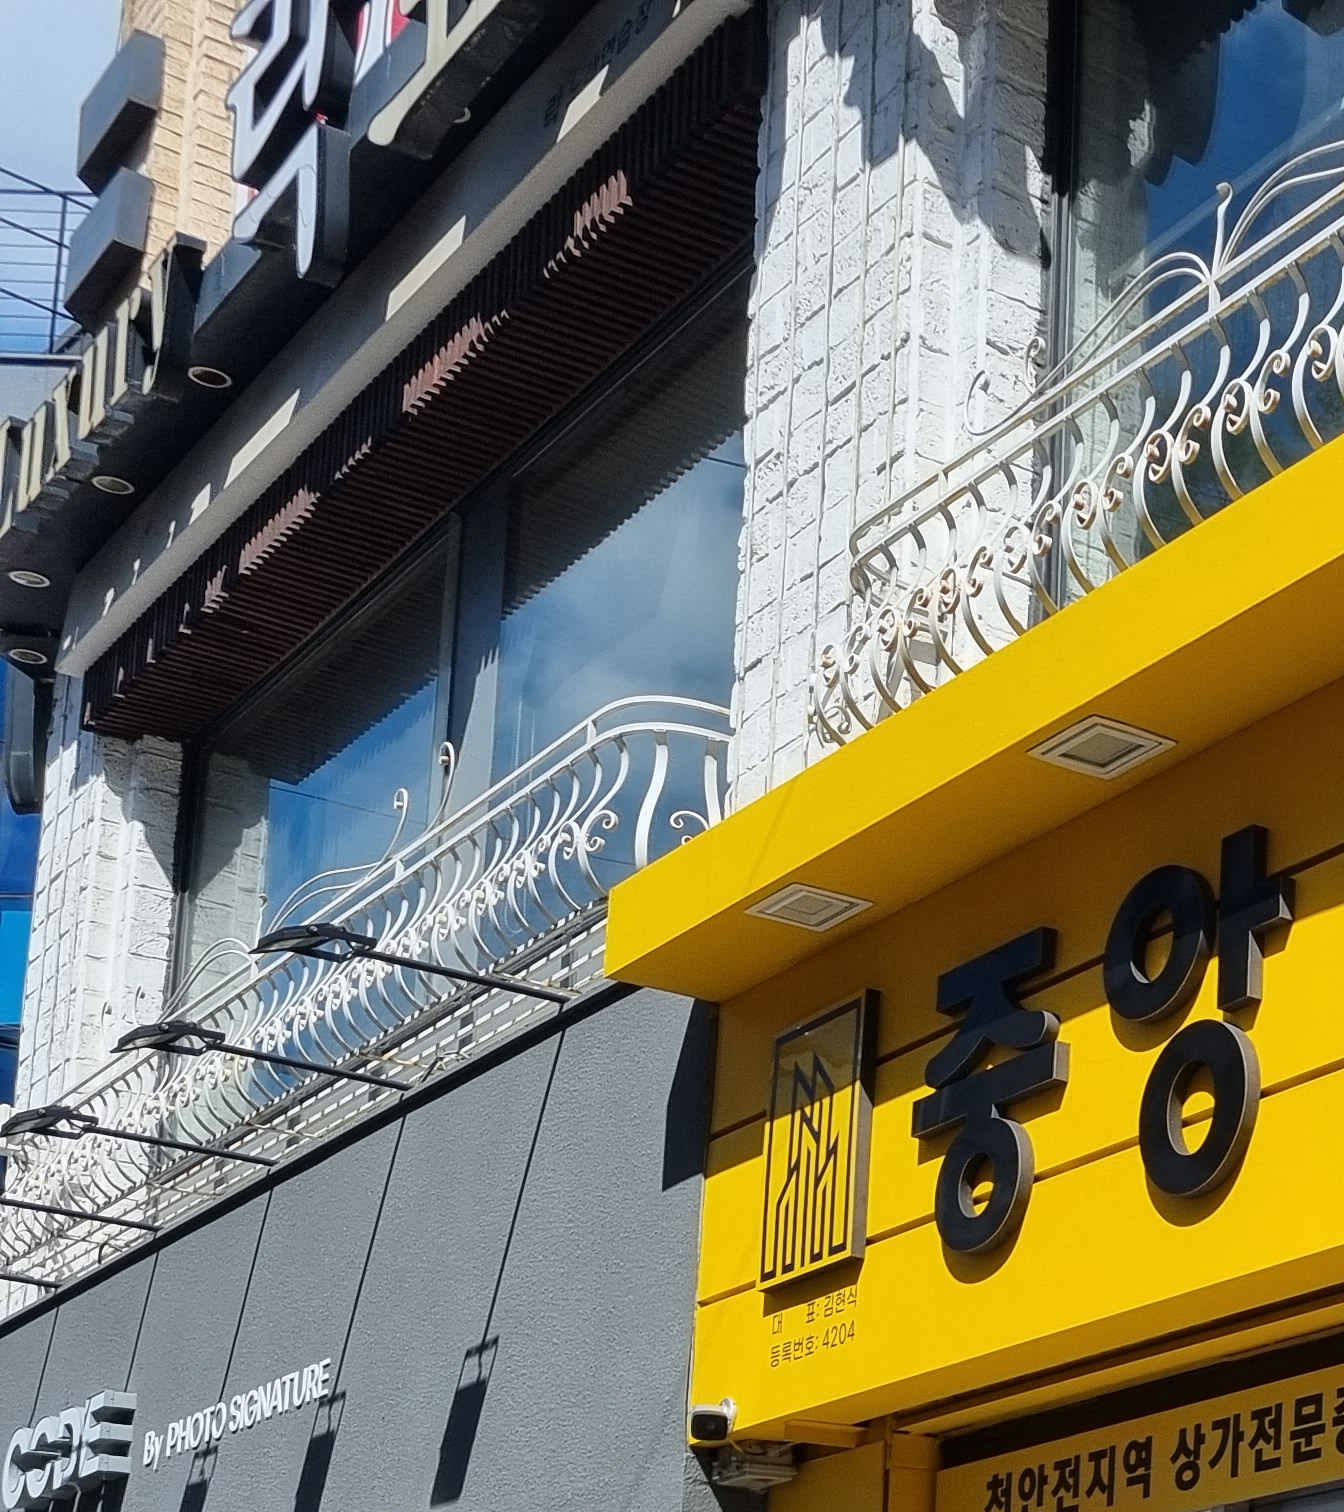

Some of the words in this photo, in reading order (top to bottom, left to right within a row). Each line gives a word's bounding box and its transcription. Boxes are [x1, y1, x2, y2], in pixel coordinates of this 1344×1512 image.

[912, 825, 1295, 1253] 중앙
[824, 1284, 858, 1318] 김현식
[771, 1334, 819, 1367] 등록번호:
[822, 1320, 855, 1349] 4204
[143, 1431, 165, 1470] By
[166, 1402, 227, 1457] PHOTO
[229, 1358, 331, 1434] SIGNATURE
